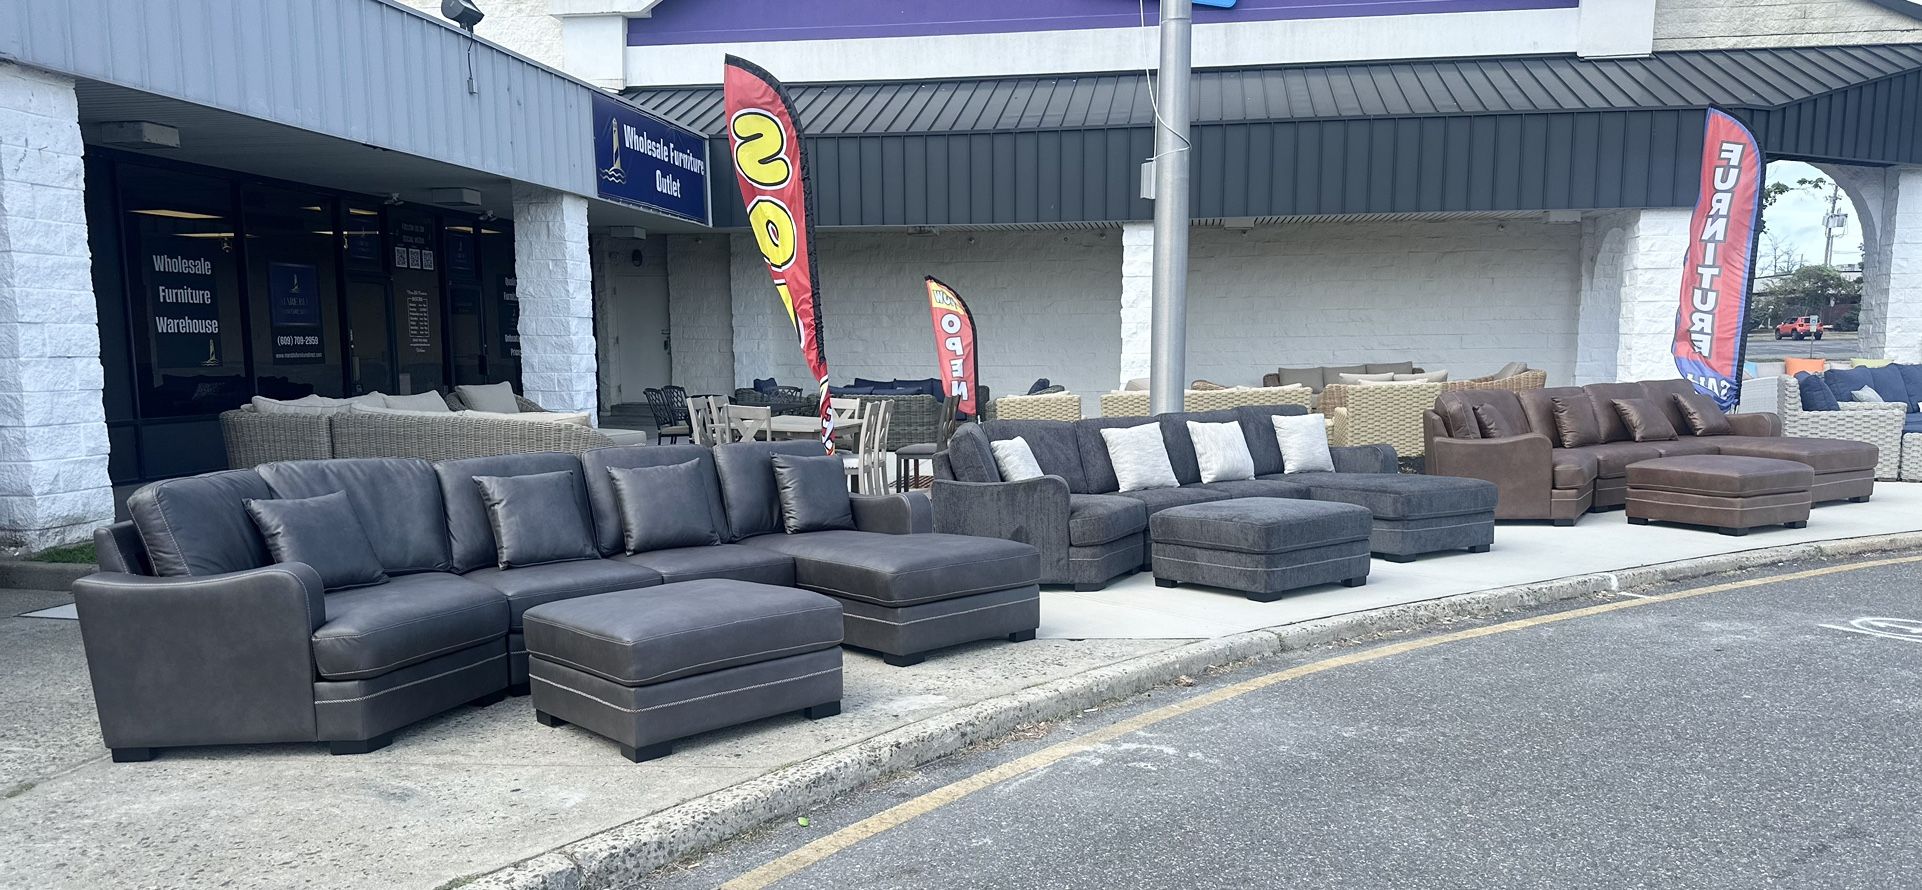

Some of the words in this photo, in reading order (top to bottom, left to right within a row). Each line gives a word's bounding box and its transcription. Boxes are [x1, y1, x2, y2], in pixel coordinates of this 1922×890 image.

[623, 123, 669, 162] Wholesale
[670, 142, 705, 176] Furniture
[655, 169, 681, 198] Outlet
[152, 254, 212, 275] Wholesale
[158, 285, 212, 304] Furniture
[155, 315, 219, 334] Warehouse
[277, 336, 294, 346] (609)
